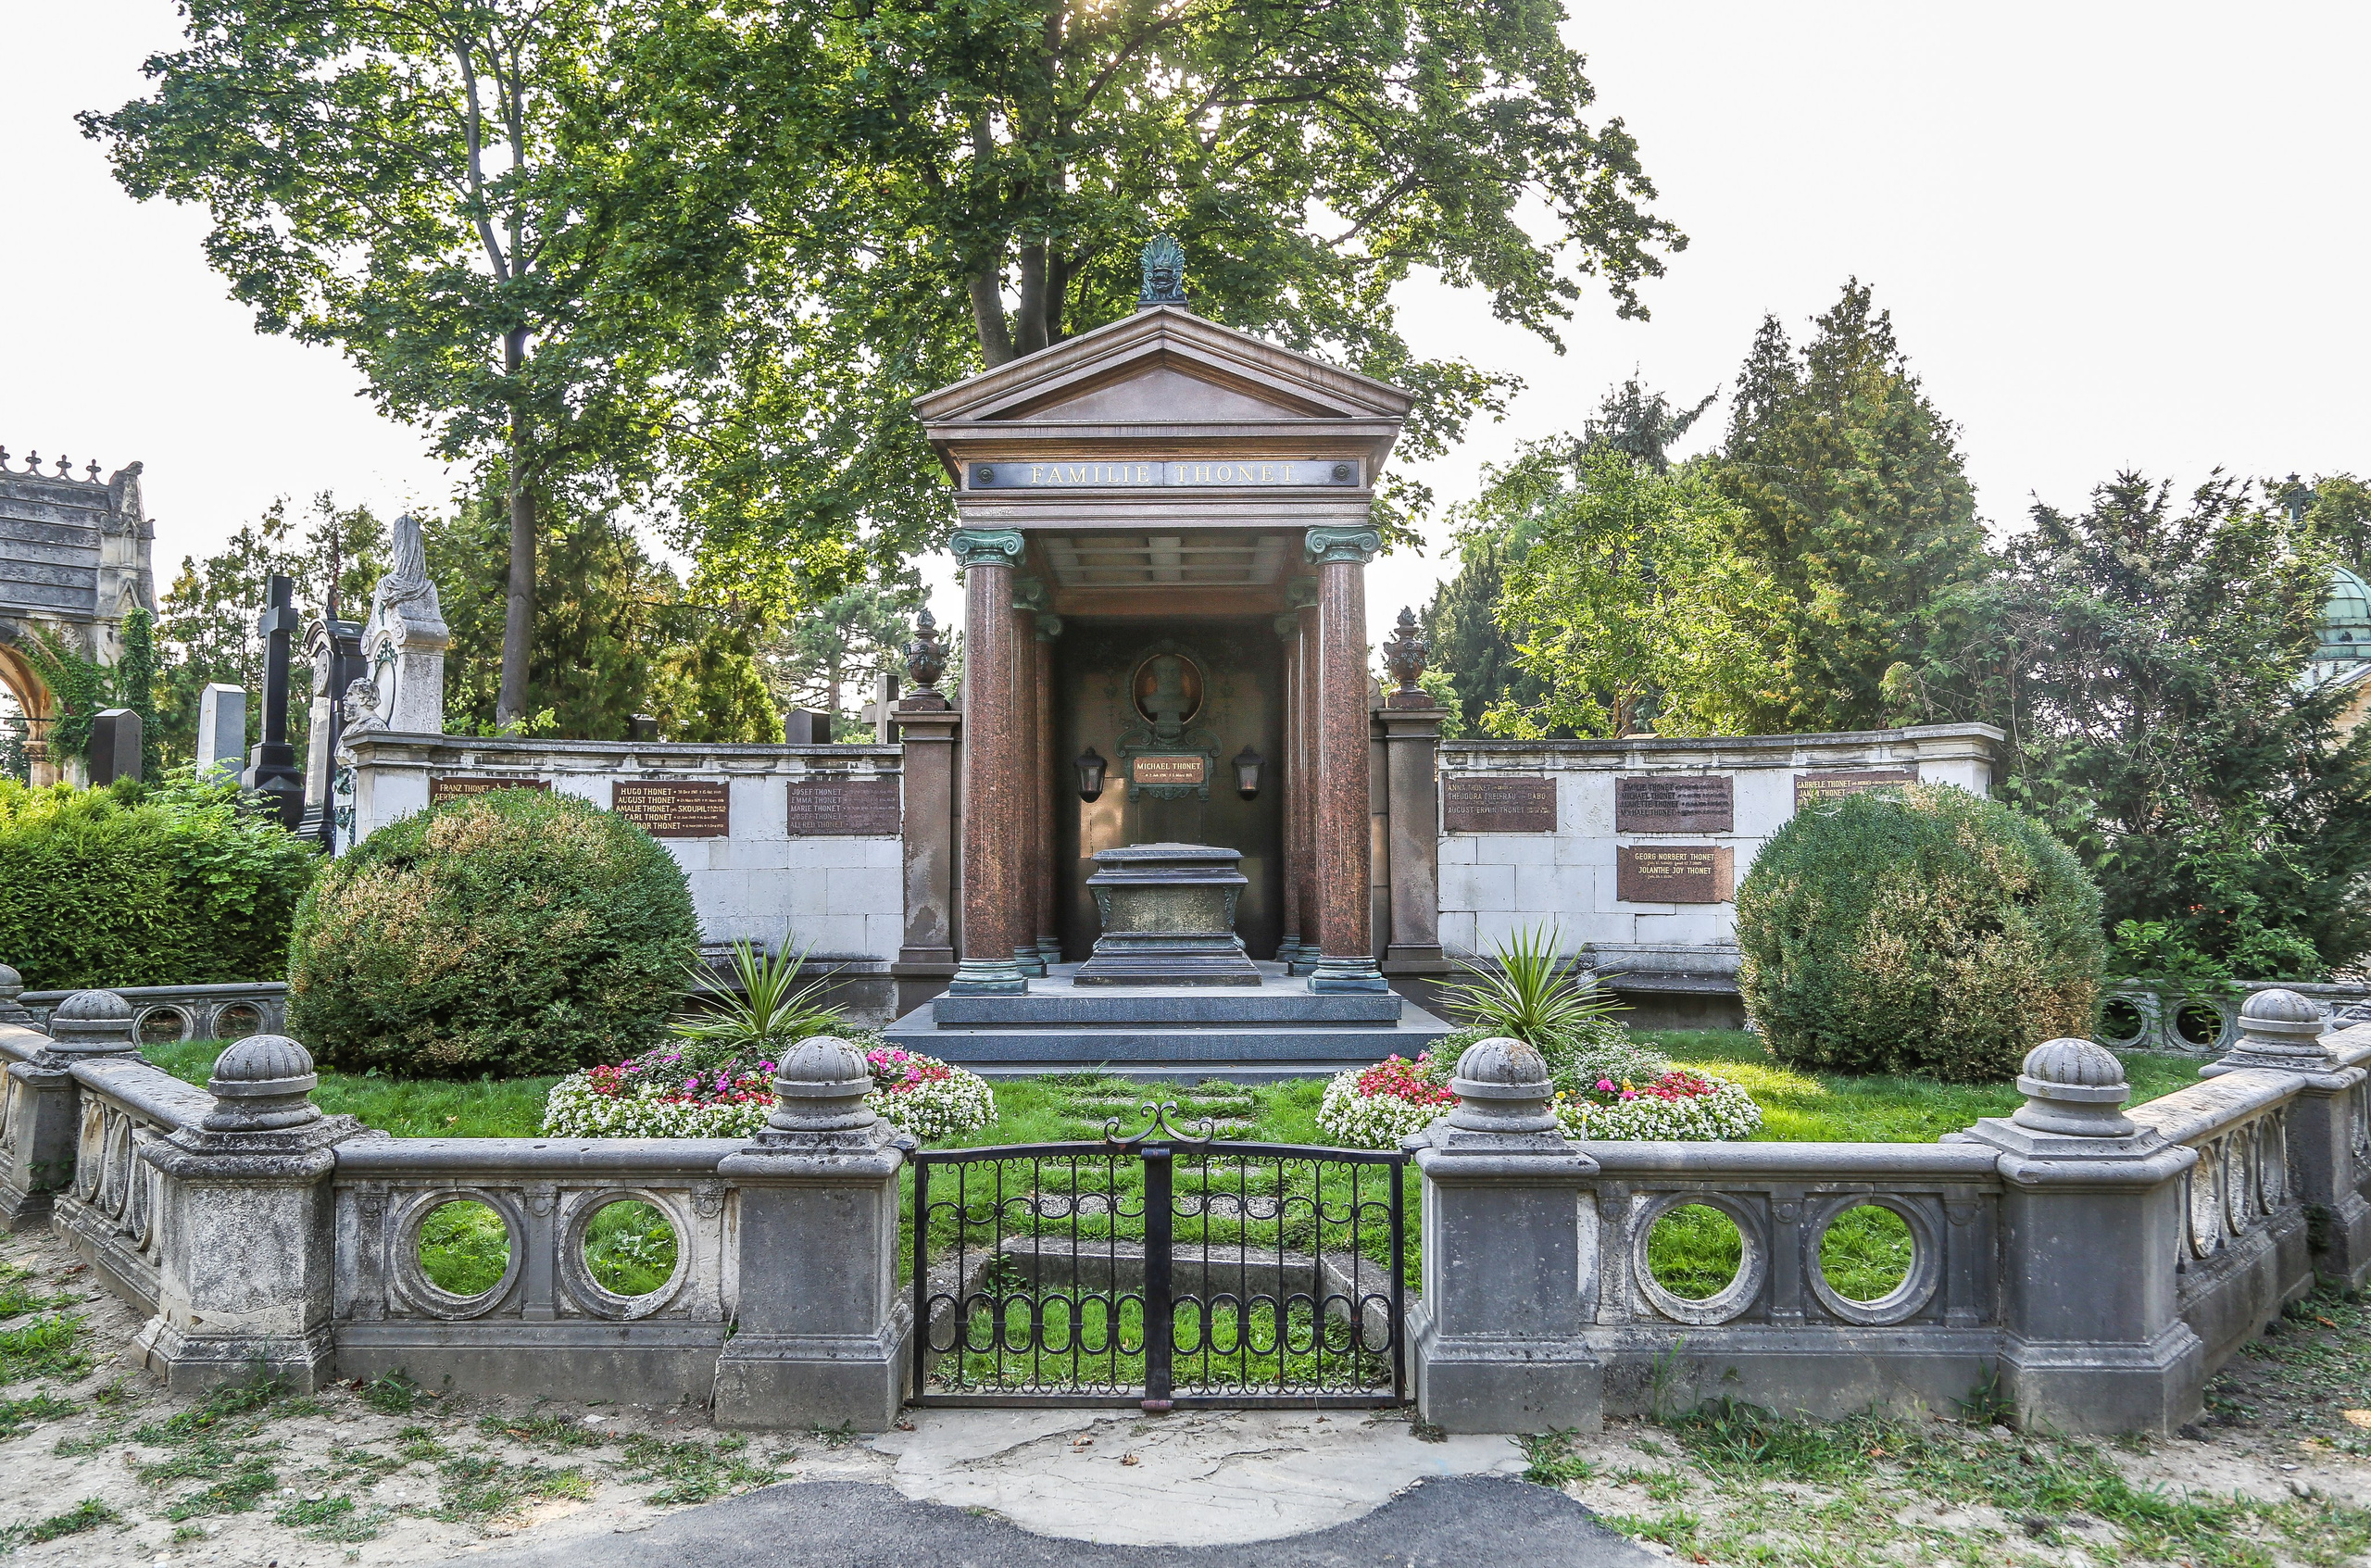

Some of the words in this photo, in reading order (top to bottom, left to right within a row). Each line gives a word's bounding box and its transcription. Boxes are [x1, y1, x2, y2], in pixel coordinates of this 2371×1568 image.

[1031, 465, 1149, 484] FAMILIE
[440, 784, 462, 792] FRANZ
[463, 784, 490, 793] THONET
[1468, 784, 1491, 792] THONET
[1648, 783, 1674, 791] THONET
[1796, 780, 1825, 789] GABRIELE
[1826, 780, 1851, 788] THONET
[621, 787, 642, 796] HUGO
[1820, 789, 1846, 797] THONET
[1448, 792, 1483, 800] THEODORA
[677, 805, 708, 813] SKOUPIL
[1448, 806, 1474, 814] AUGUST
[1499, 806, 1525, 814] THONET
[652, 822, 681, 830] THONET
[1689, 853, 1714, 861] THONET
[1637, 866, 1670, 874] JOLANTHE
[1672, 866, 1685, 874] JOY
[1687, 867, 1712, 875] THONET
